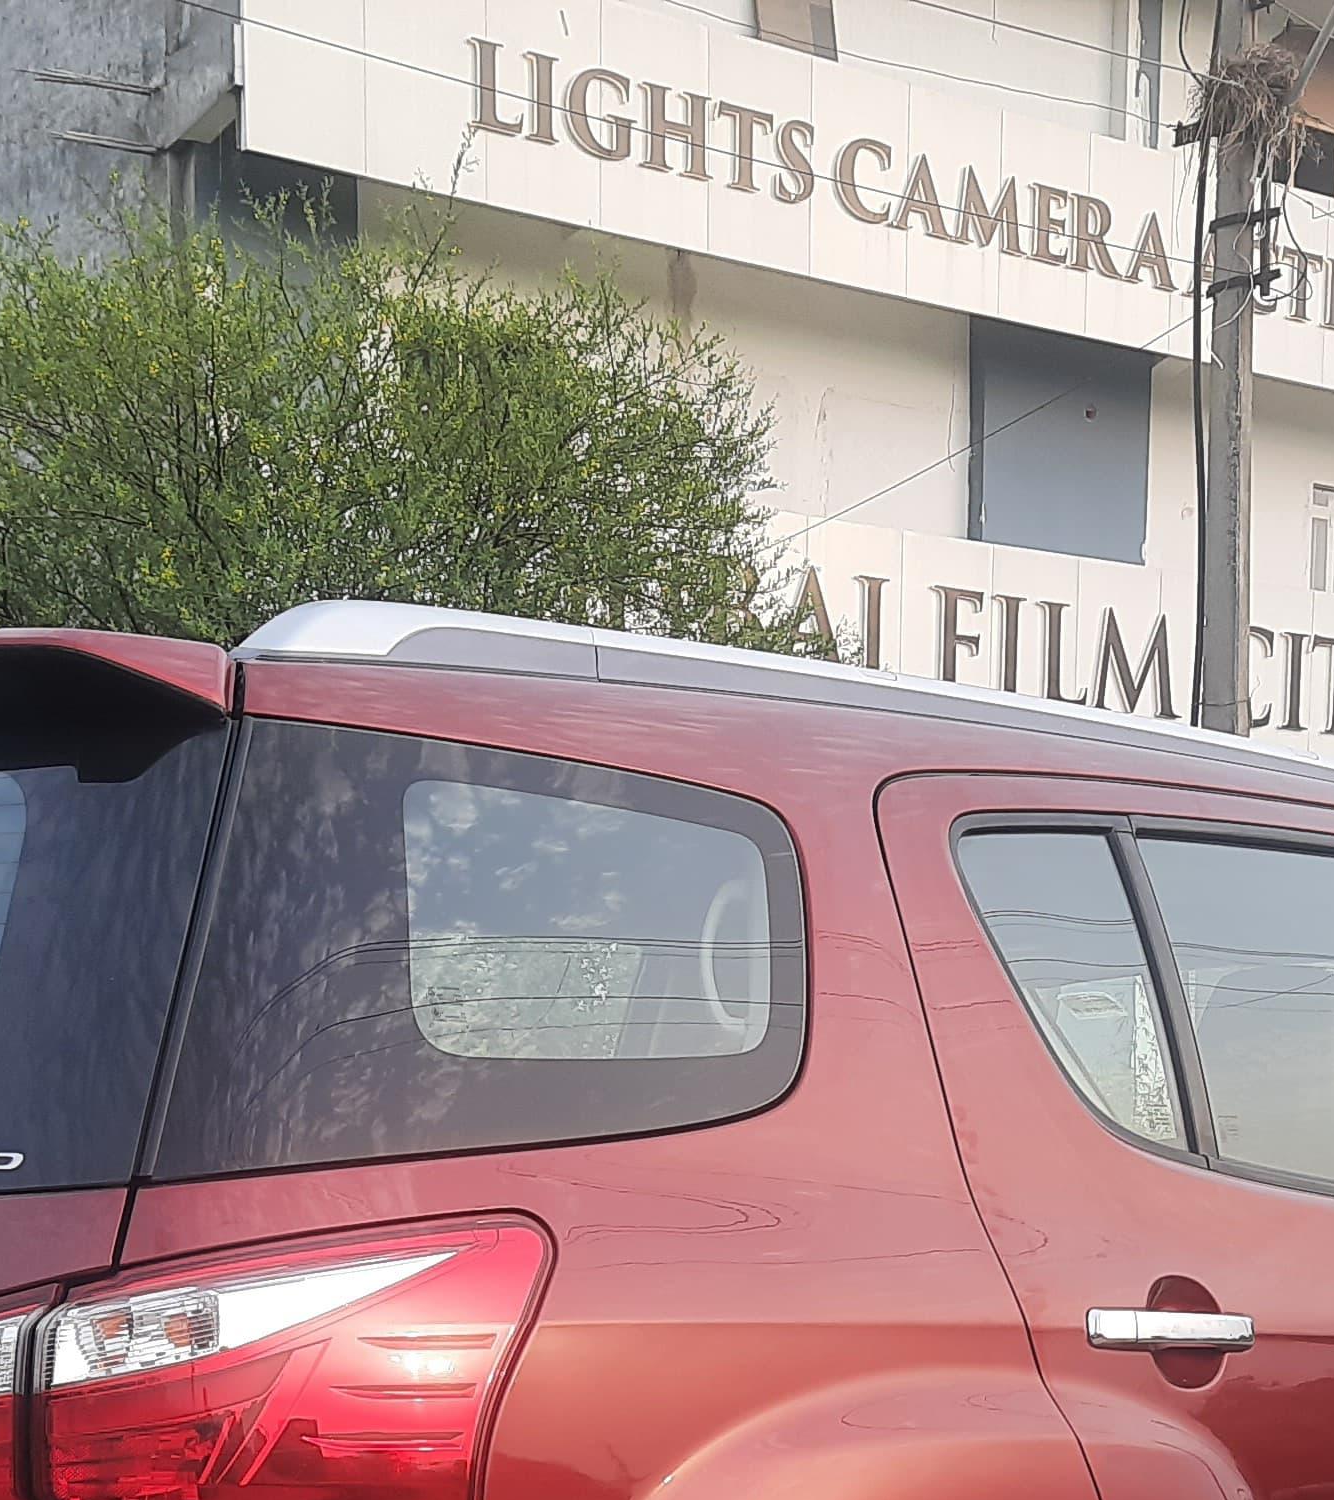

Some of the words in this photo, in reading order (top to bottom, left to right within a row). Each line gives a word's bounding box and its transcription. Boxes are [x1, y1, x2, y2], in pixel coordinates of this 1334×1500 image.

[467, 36, 816, 204] LIGHTS
[833, 137, 1179, 292] CAMERA
[928, 584, 1183, 720] FILM
